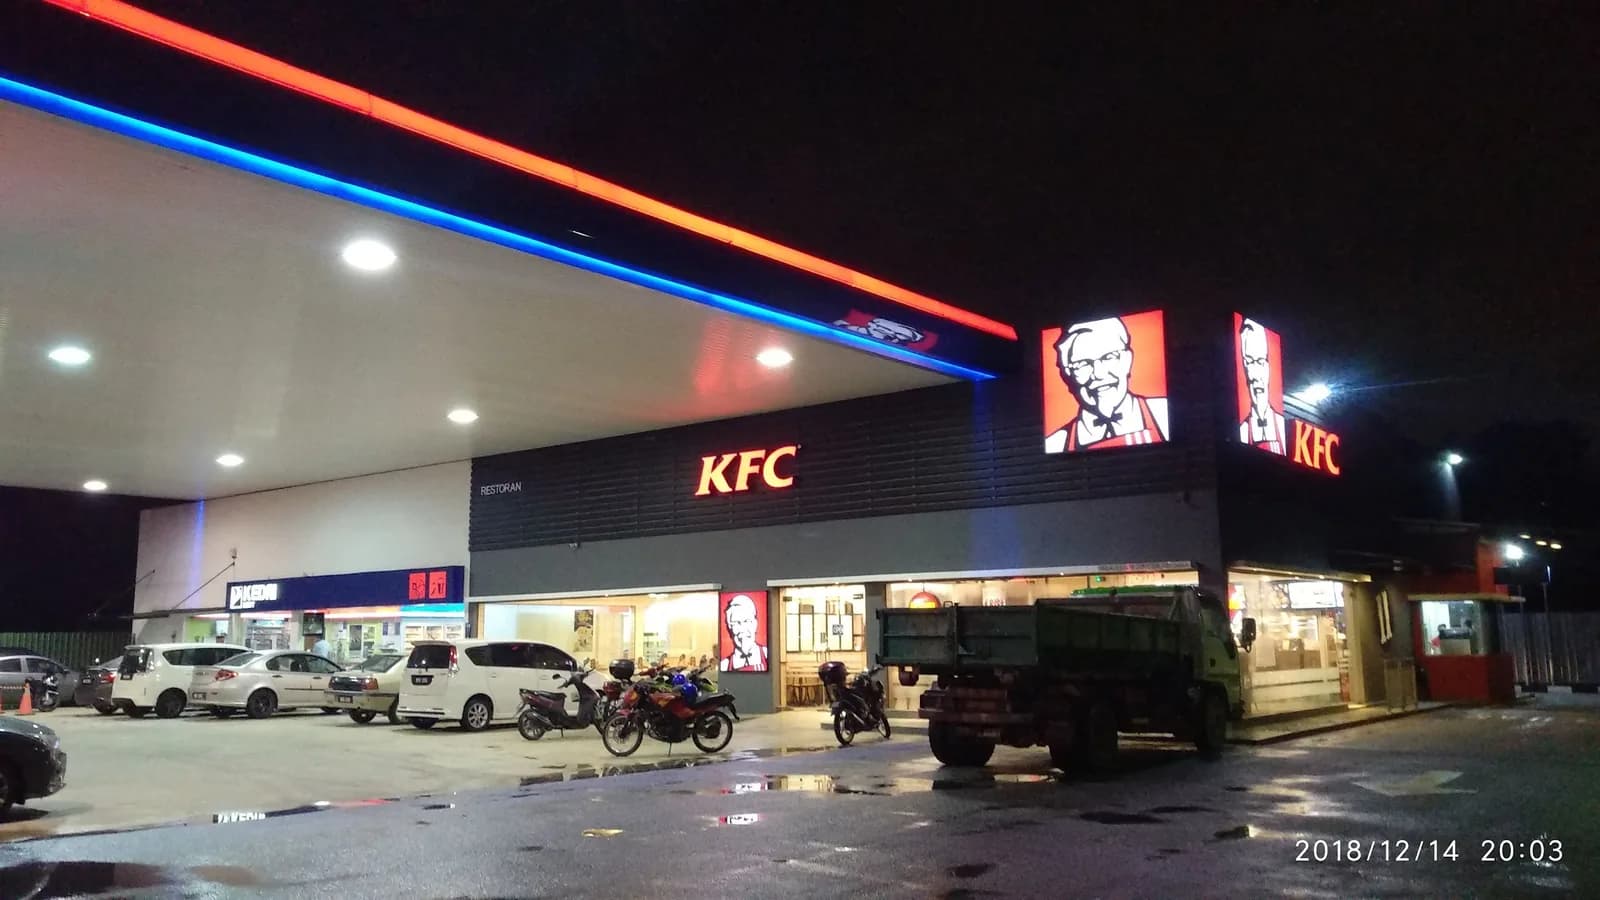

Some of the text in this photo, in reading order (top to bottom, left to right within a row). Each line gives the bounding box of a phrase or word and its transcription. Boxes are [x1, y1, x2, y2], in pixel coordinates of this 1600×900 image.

[695, 446, 797, 497] KFC
[1293, 419, 1340, 476] KFC
[480, 481, 522, 496] RESTORAN
